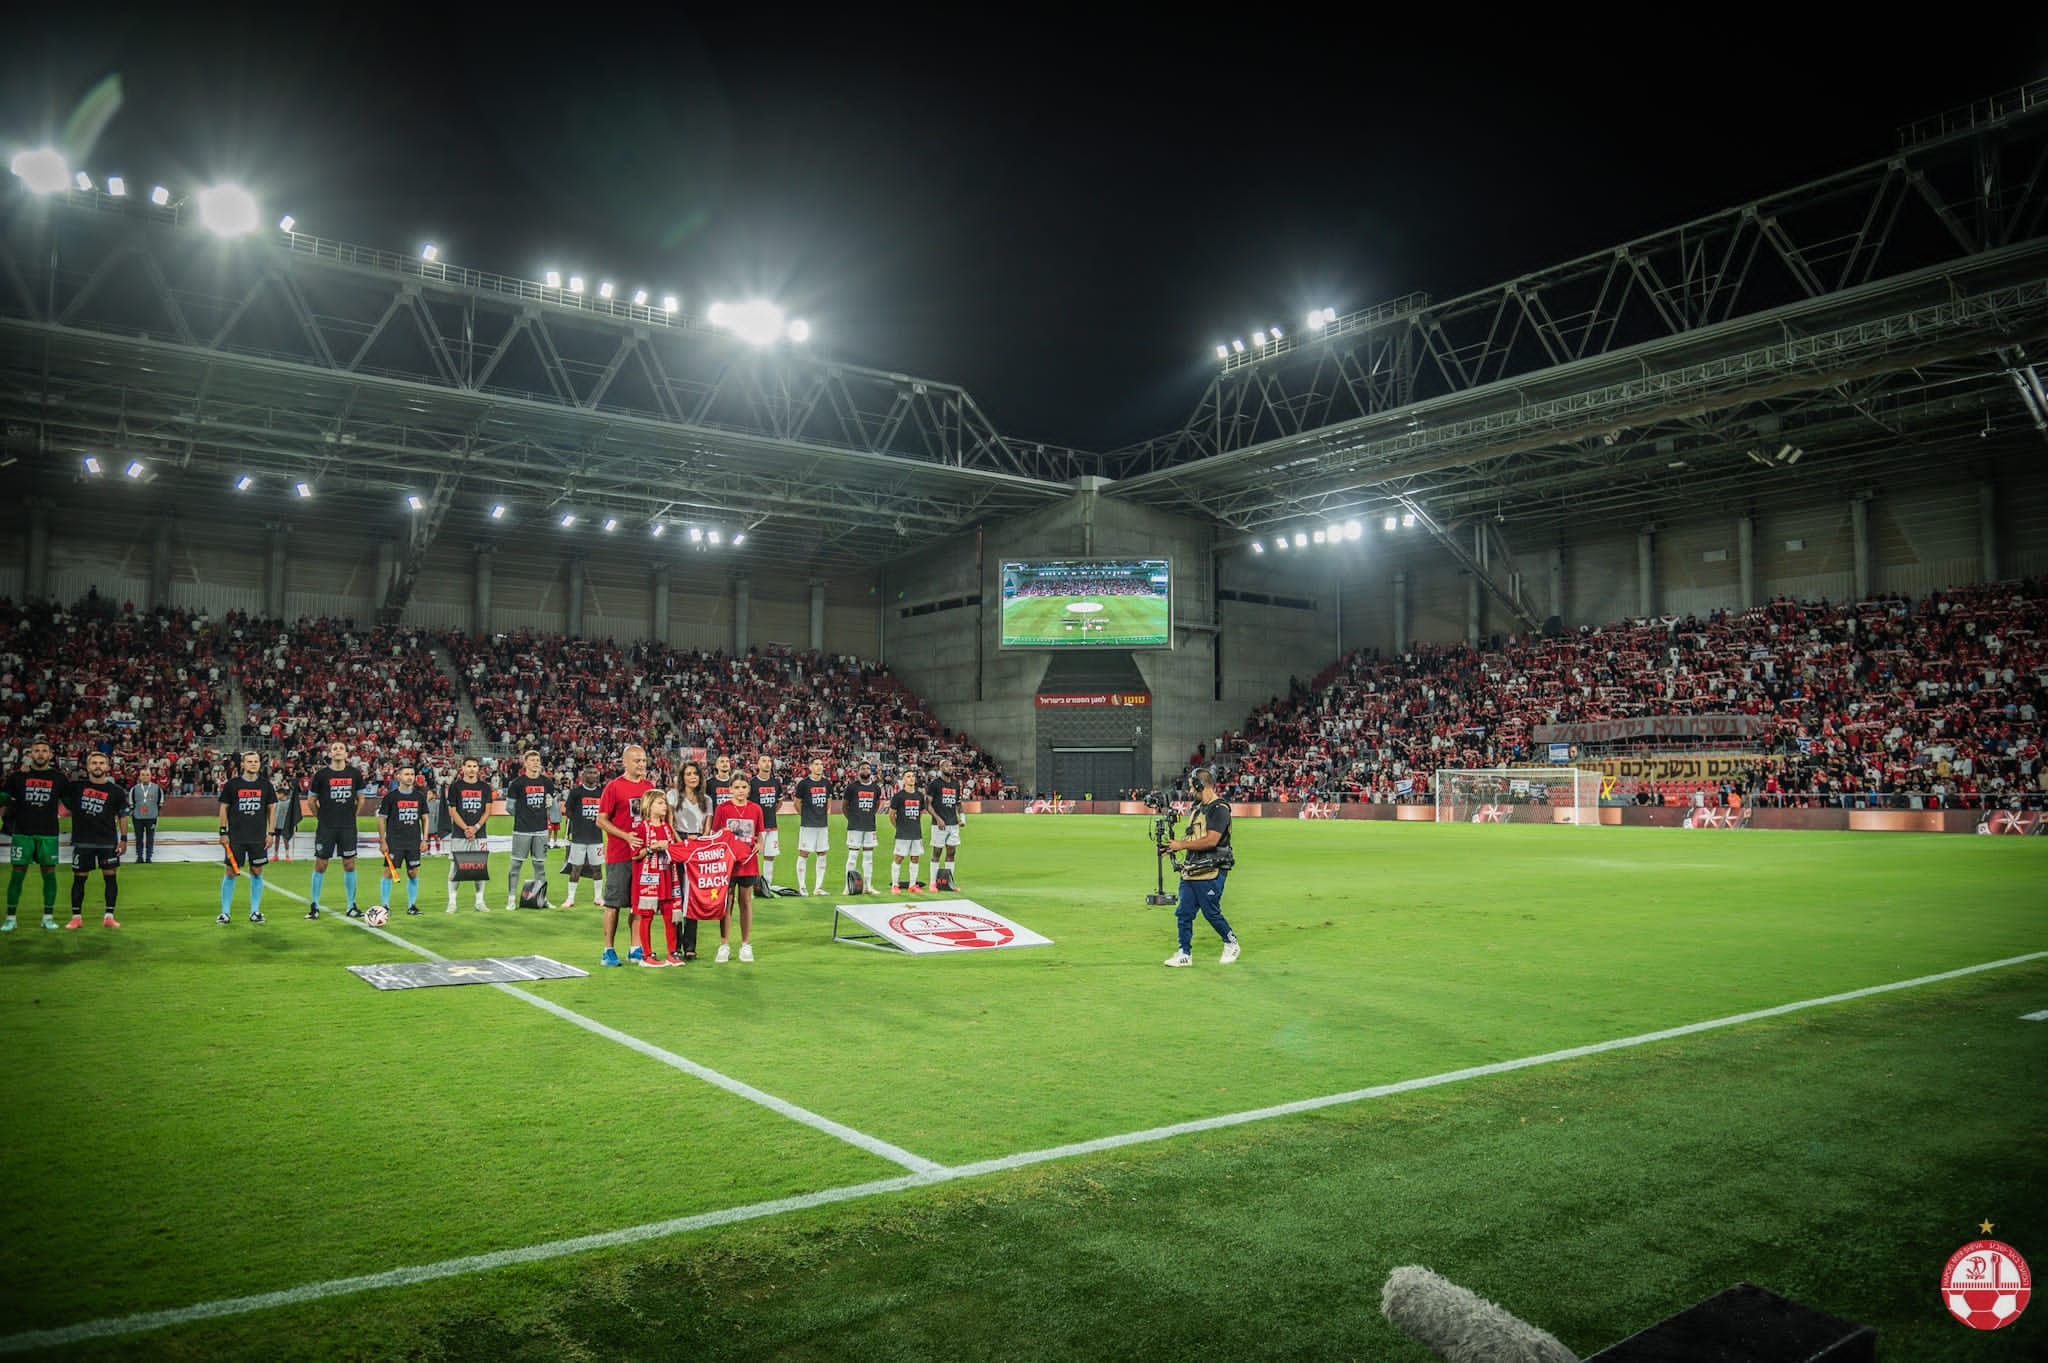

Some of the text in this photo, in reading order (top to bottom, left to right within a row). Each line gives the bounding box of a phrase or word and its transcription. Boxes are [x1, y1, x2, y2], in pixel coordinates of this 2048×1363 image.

[1039, 696, 1065, 704] בישראל
[1065, 696, 1090, 704] הספורט
[1652, 716, 1685, 735] ולא
[1689, 717, 1739, 735] נשכח
[1552, 725, 1589, 742] 7/10
[1620, 759, 1702, 779] ובשבילכם
[330, 789, 352, 799] כולם
[239, 801, 261, 811] כולם
[462, 800, 482, 809] כולם
[399, 811, 418, 821] כולם
[697, 848, 725, 861] BRING
[698, 861, 728, 875] THEM
[698, 875, 729, 889] BACK
